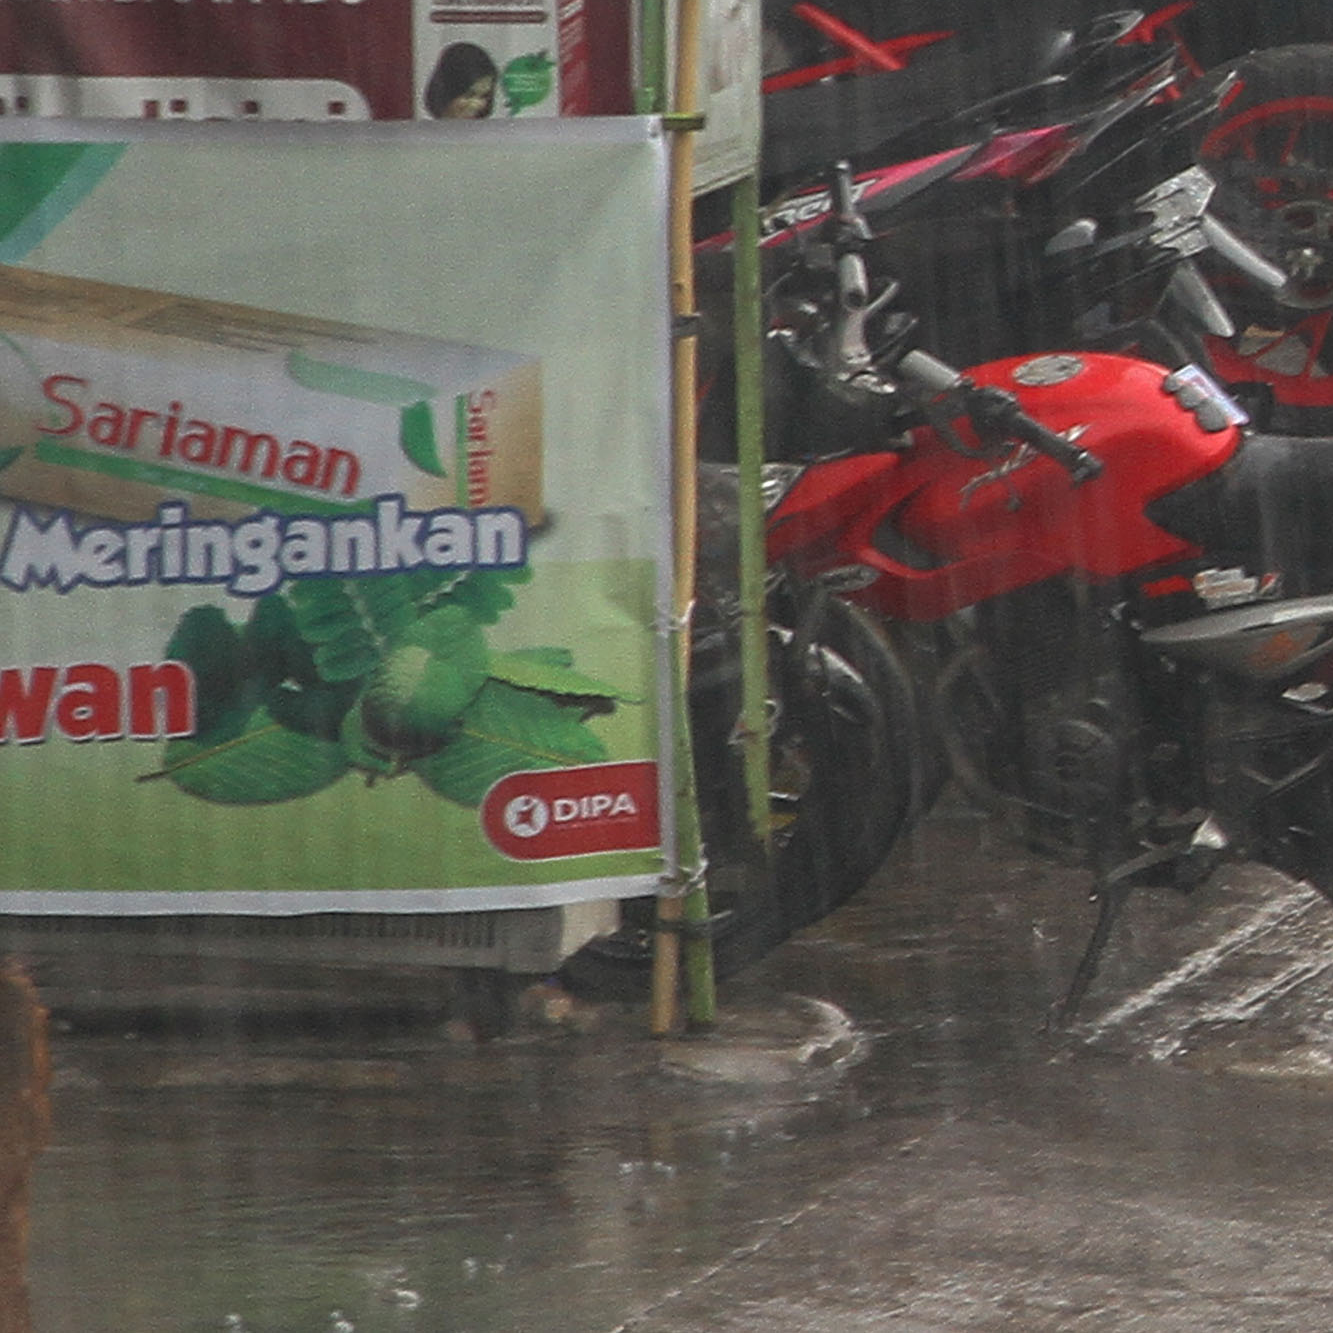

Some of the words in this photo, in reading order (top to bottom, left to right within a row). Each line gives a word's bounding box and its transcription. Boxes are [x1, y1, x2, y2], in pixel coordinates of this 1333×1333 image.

[36, 374, 362, 496] Sariaman
[2, 494, 529, 594] Meringankan
[553, 793, 637, 822] DIPA
